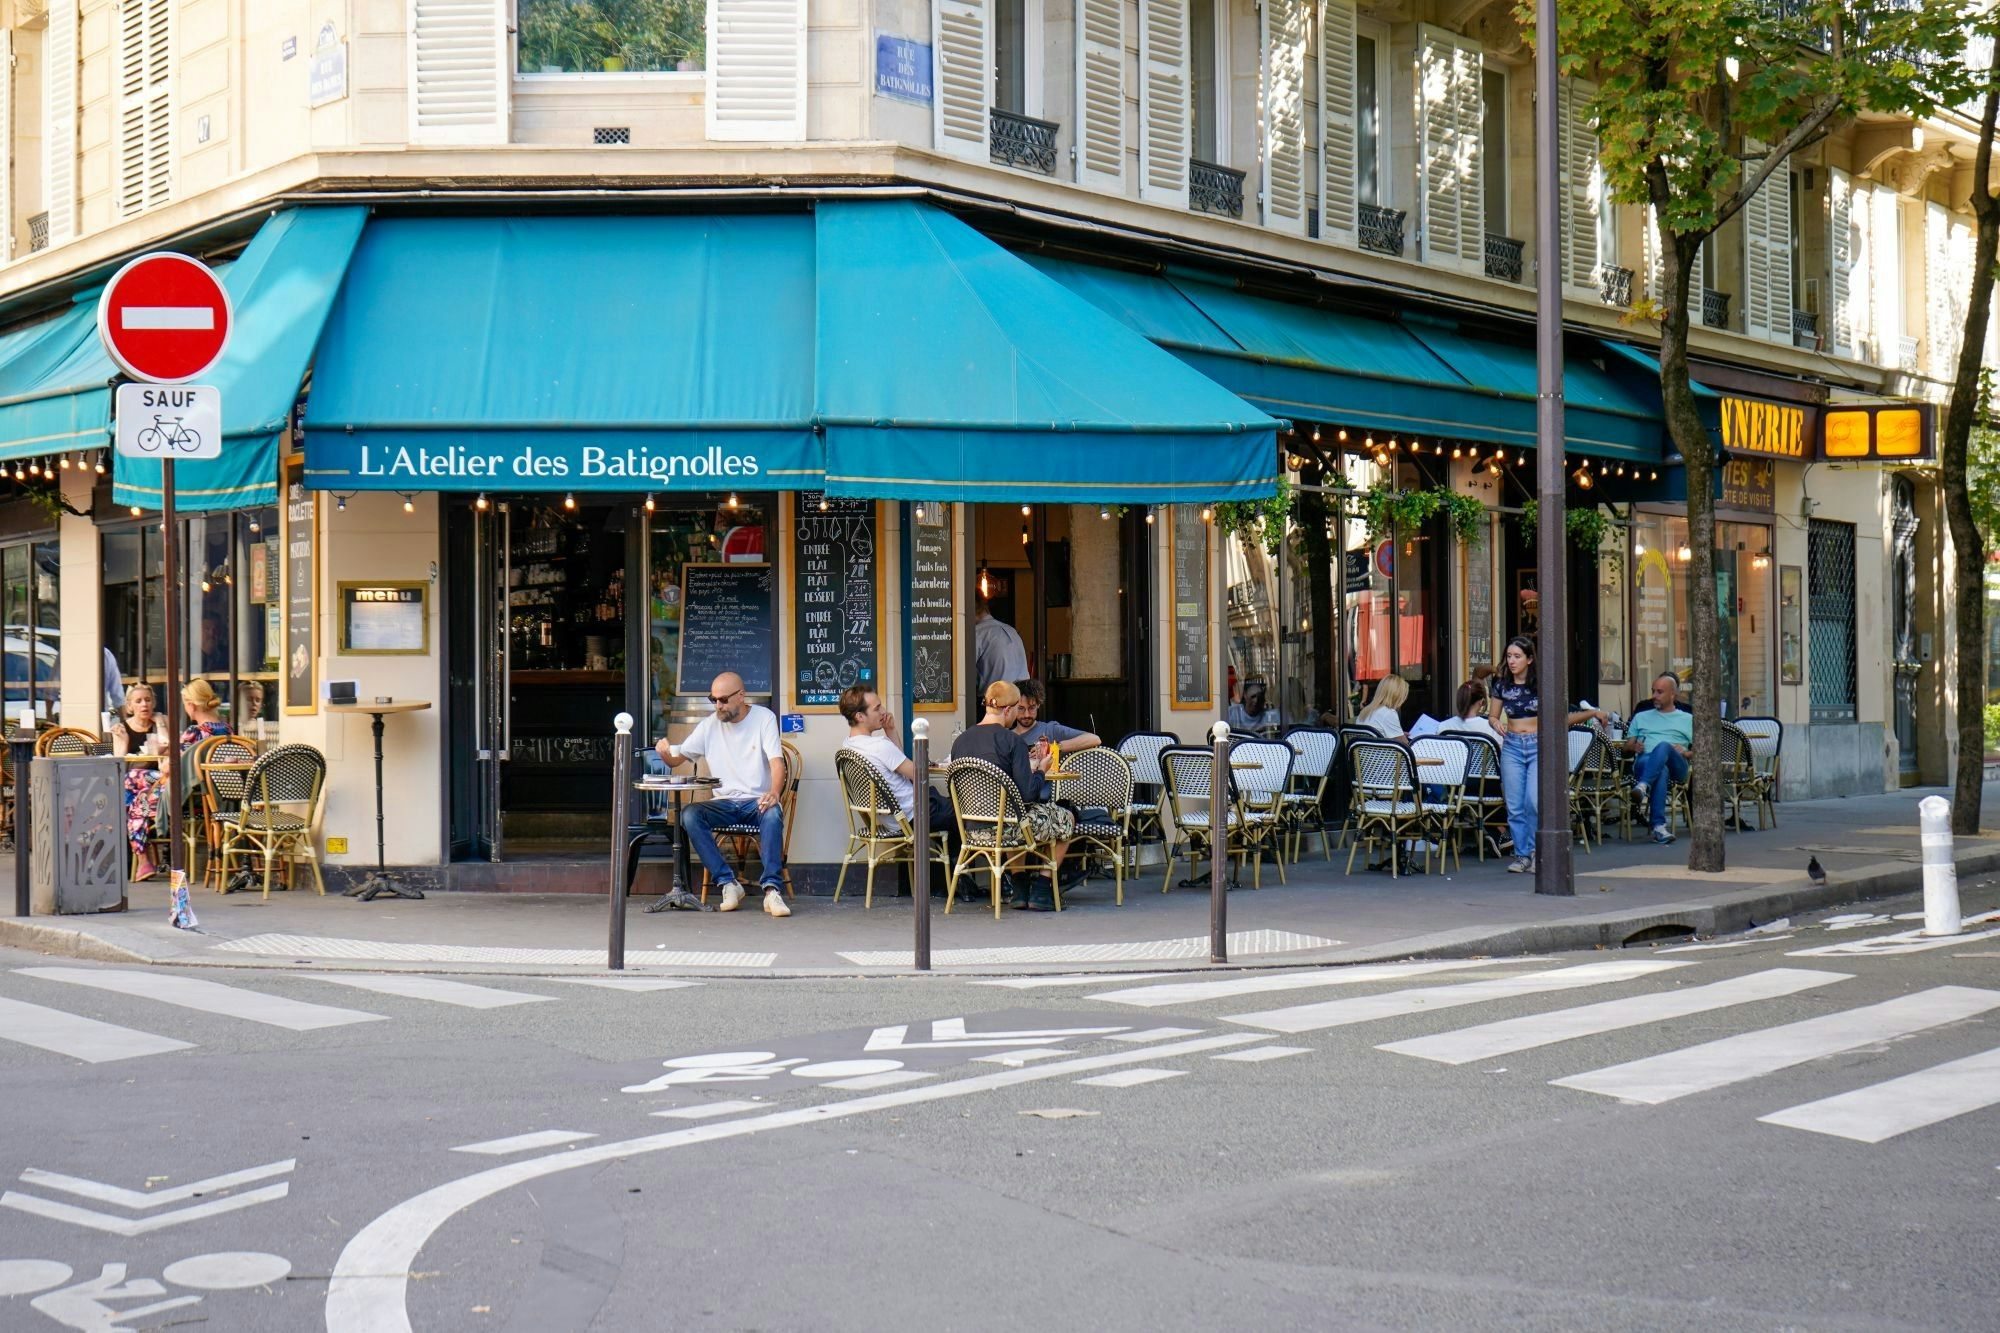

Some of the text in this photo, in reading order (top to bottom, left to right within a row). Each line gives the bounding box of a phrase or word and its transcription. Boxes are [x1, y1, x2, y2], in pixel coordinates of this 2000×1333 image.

[897, 46, 915, 61] RUE
[898, 63, 914, 76] DES
[880, 74, 931, 97] BATIGNOLLES
[143, 390, 196, 408] SAUF
[358, 445, 760, 485] L'Atelier des Batignolles
[1738, 491, 1748, 505] DE
[1749, 493, 1771, 507] VISITE
[803, 542, 831, 555] ENTRÉE
[807, 560, 828, 571] PLAT
[807, 575, 828, 586] PLAT
[355, 590, 412, 601] menu
[804, 591, 835, 603] DESSERT
[805, 609, 832, 622] ENTRÉE
[808, 628, 828, 639] PLAT
[806, 642, 836, 654] DESSERT
